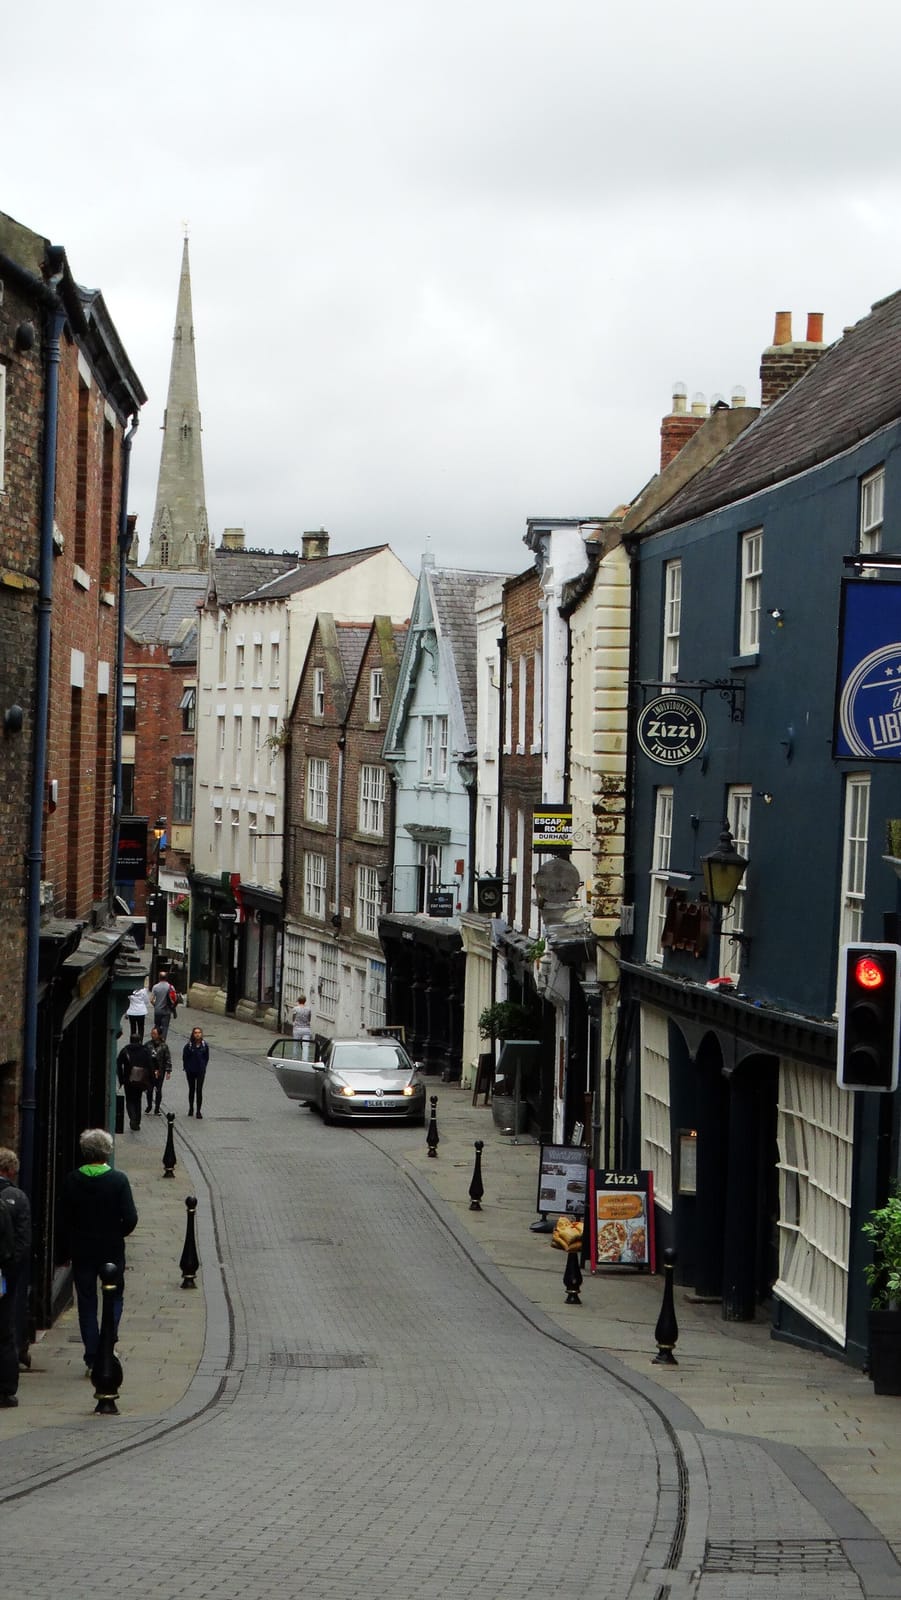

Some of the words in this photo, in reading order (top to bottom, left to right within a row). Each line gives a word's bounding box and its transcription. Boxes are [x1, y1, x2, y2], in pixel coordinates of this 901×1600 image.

[652, 701, 694, 716] INDIVIDUALLY
[647, 720, 696, 739] Zizzi
[868, 711, 901, 745] LIB
[650, 743, 691, 759] ITALIAN
[604, 1172, 639, 1185] Zizzi
